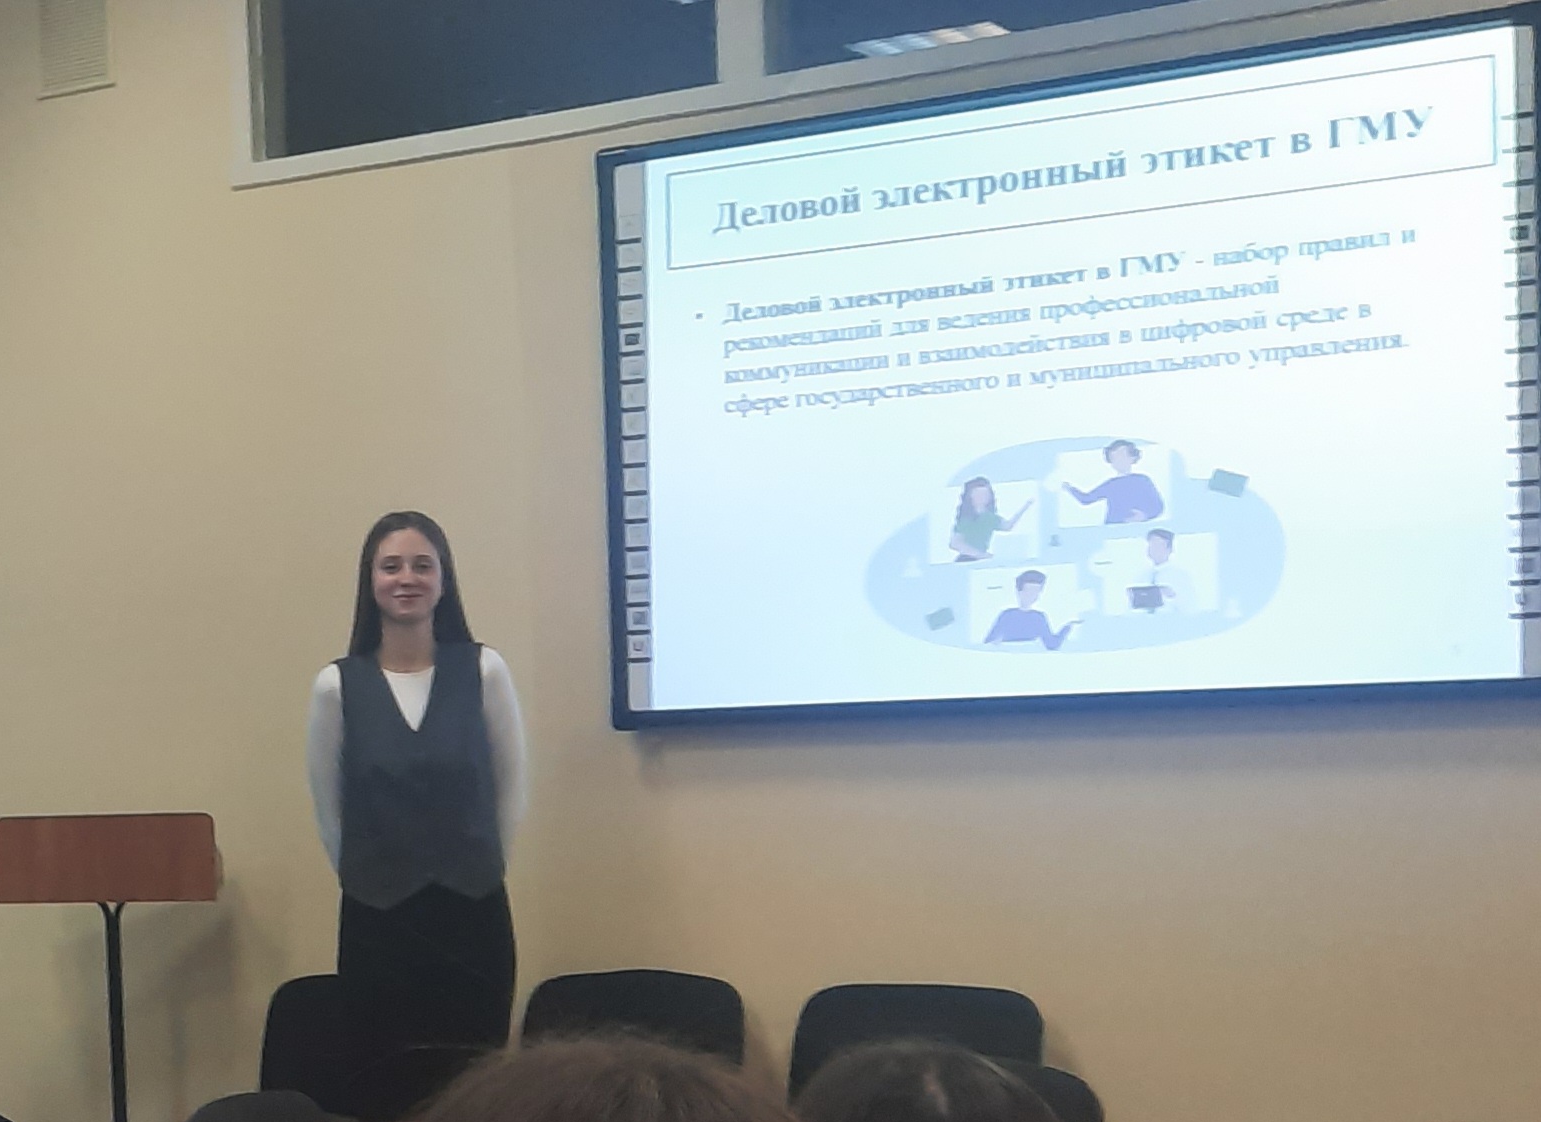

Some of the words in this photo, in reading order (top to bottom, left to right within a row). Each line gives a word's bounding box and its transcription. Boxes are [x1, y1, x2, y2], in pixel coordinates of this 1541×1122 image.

[711, 186, 862, 234] Деловой
[871, 149, 1127, 212] электронный
[1140, 136, 1277, 174] этикет
[1289, 131, 1313, 155] в
[1327, 105, 1434, 149] ГМУ
[722, 295, 823, 324] Деловой
[829, 275, 994, 311] электронный
[1002, 268, 1088, 292] этикет
[1096, 266, 1111, 280] в
[1119, 250, 1187, 278] ГМУ
[1213, 241, 1289, 266] набор
[1299, 231, 1391, 261] правил
[1401, 229, 1416, 244] и
[896, 352, 911, 367] и
[1118, 329, 1132, 344] в
[1140, 310, 1268, 344] цифровой
[1276, 306, 1349, 332] среде
[1358, 303, 1372, 318] в
[724, 393, 789, 418] сфере
[1007, 372, 1022, 388] и
